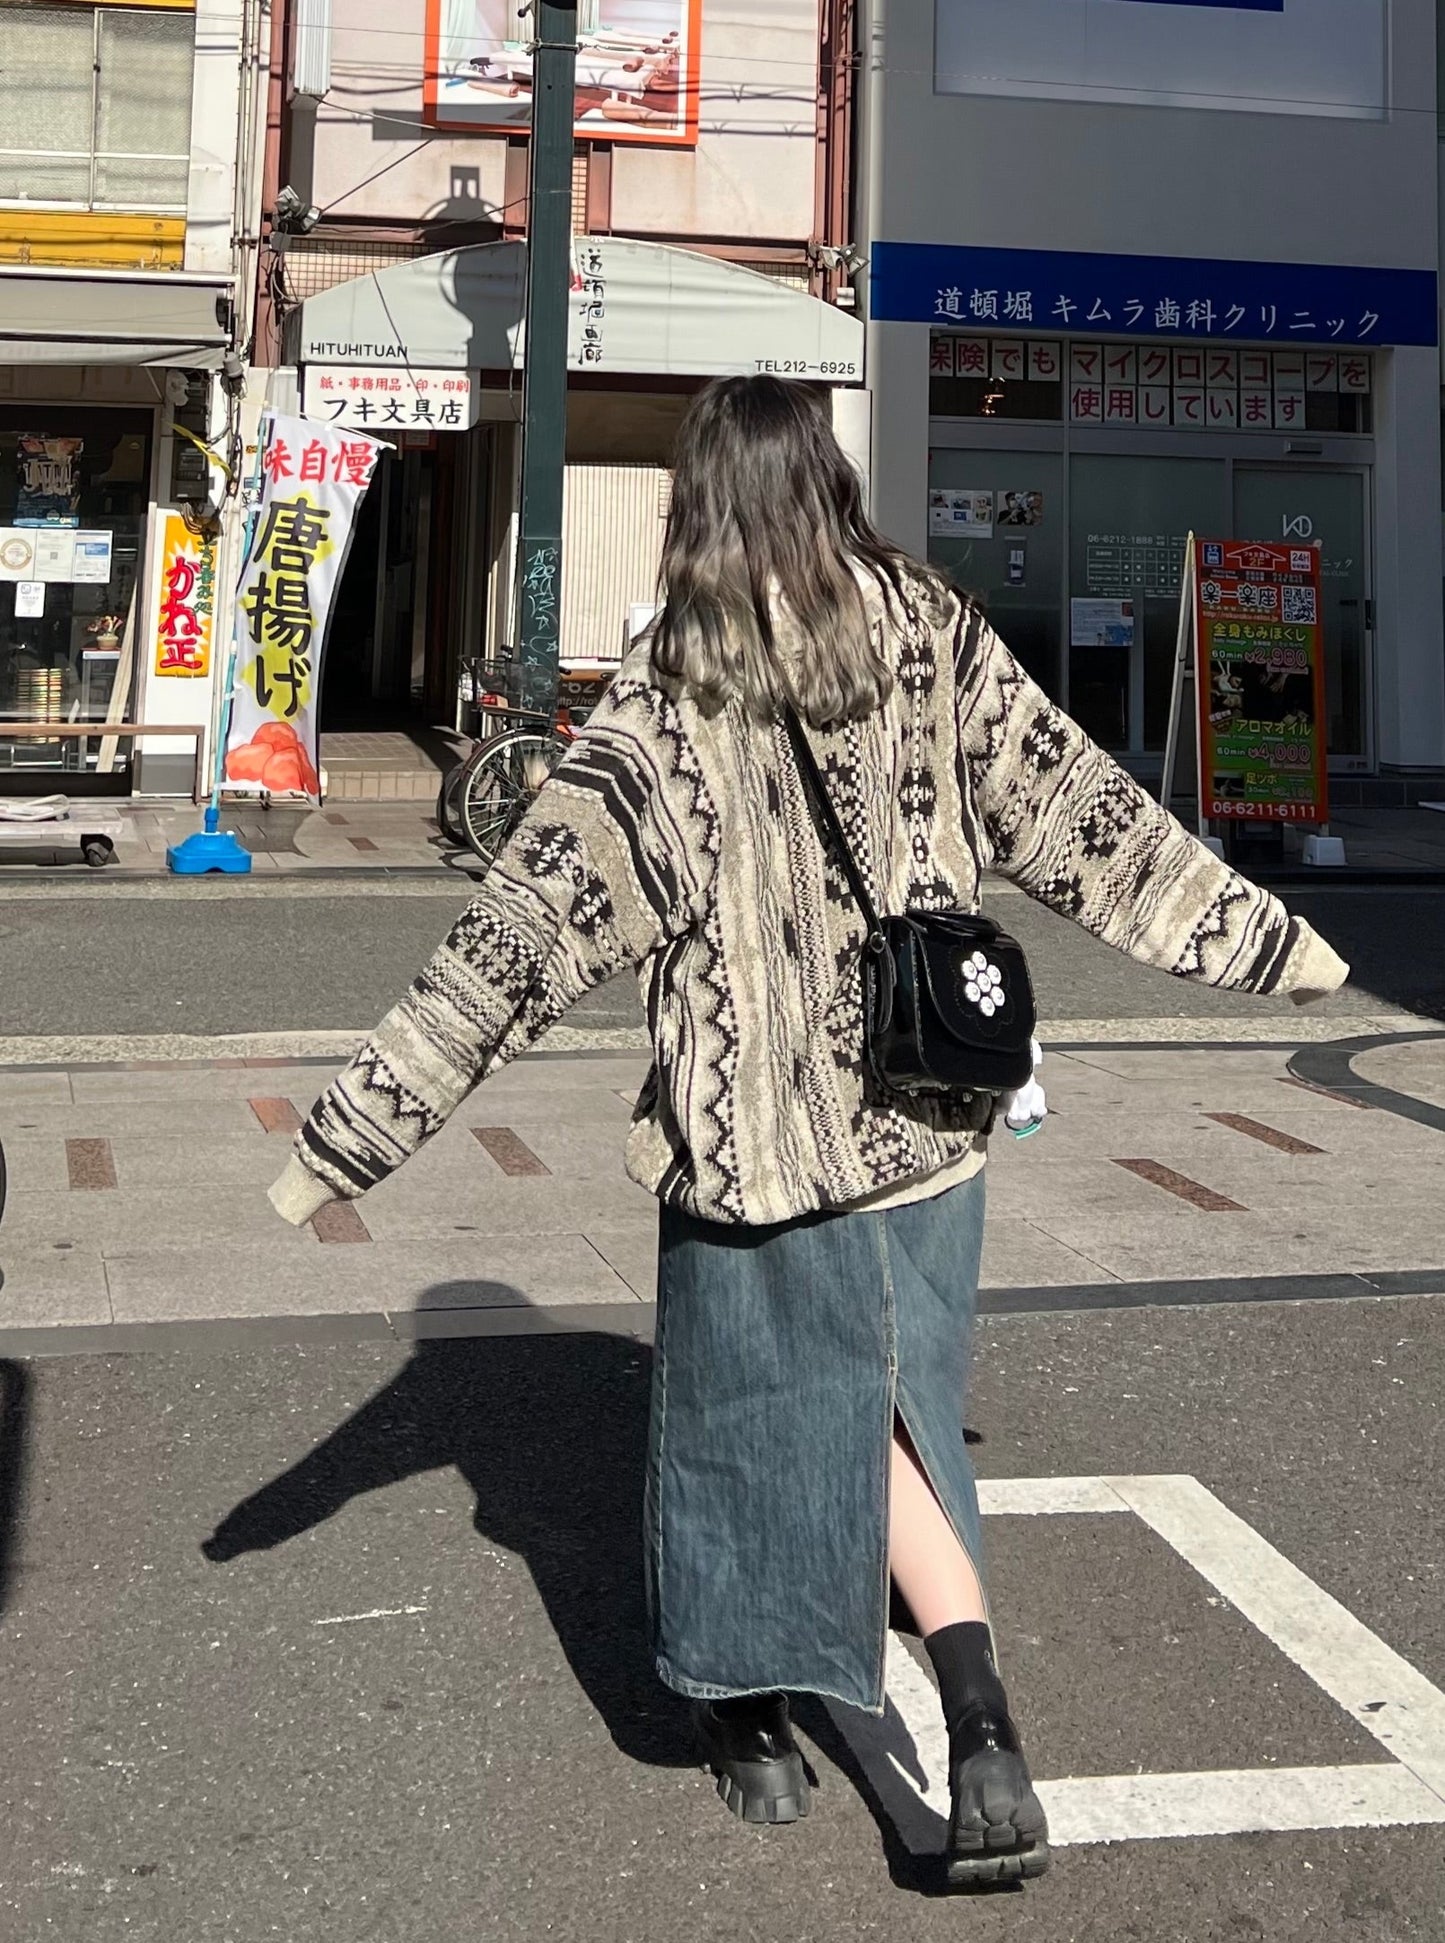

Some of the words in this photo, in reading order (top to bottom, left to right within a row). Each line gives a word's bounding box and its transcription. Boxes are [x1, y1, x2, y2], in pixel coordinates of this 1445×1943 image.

[934, 286, 1034, 322] 道頓堀
[1051, 295, 1382, 339] キムラ歯科クリニック
[310, 342, 408, 358] HITUHITUAN
[930, 341, 1057, 376] 保険でも
[1072, 350, 1369, 388] マイクロスコープを
[320, 376, 471, 393] 紙・事務用品・印・印刷
[323, 397, 464, 425] フキ文具店
[1072, 386, 1305, 424] 使用しています
[263, 439, 375, 487] 味自慢
[1249, 557, 1265, 567] 2F
[1292, 552, 1310, 562] 24H
[158, 555, 203, 670] かね正
[247, 497, 331, 718] 唐揚げ
[1213, 622, 1306, 642] 全身もみほぐし
[1211, 648, 1243, 660] 60min
[1235, 718, 1312, 736] アロマオイル
[1216, 747, 1246, 756] 60min
[1212, 800, 1316, 818] 06-6211-6111
